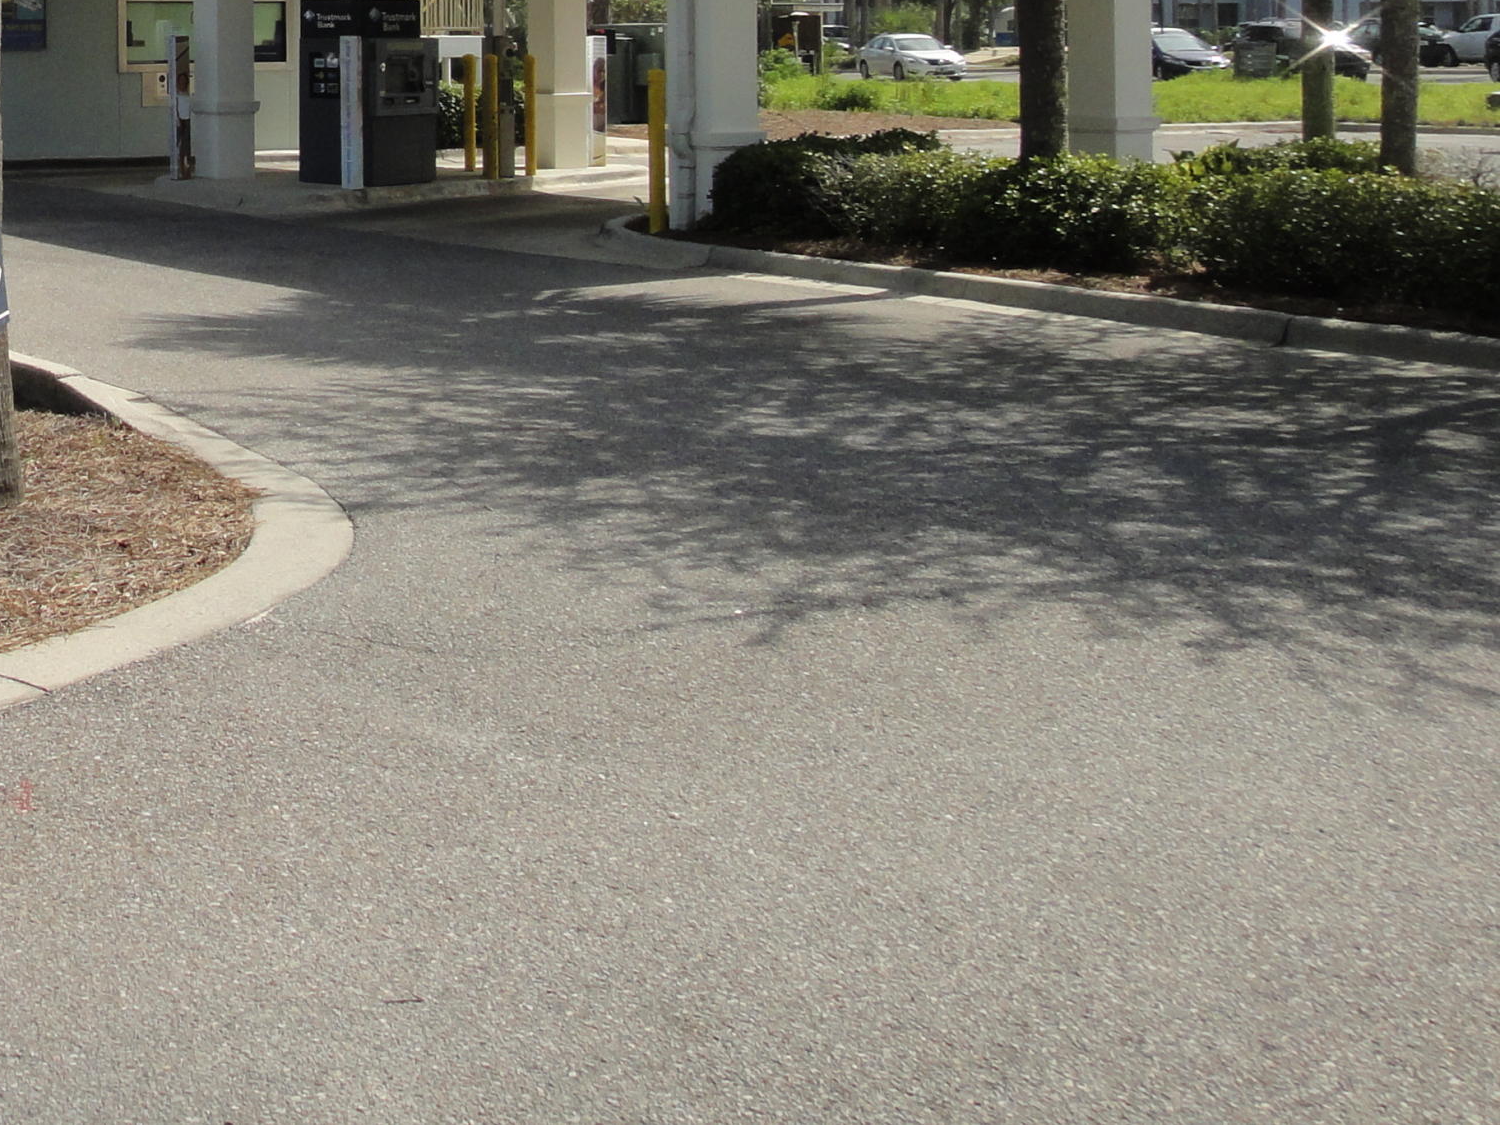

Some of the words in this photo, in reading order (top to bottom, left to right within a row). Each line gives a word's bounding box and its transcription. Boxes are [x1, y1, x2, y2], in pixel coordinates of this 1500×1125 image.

[316, 12, 351, 21] Trustmark
[382, 11, 416, 21] Trustmark
[317, 21, 335, 29] Bank
[382, 22, 400, 32] Bank
